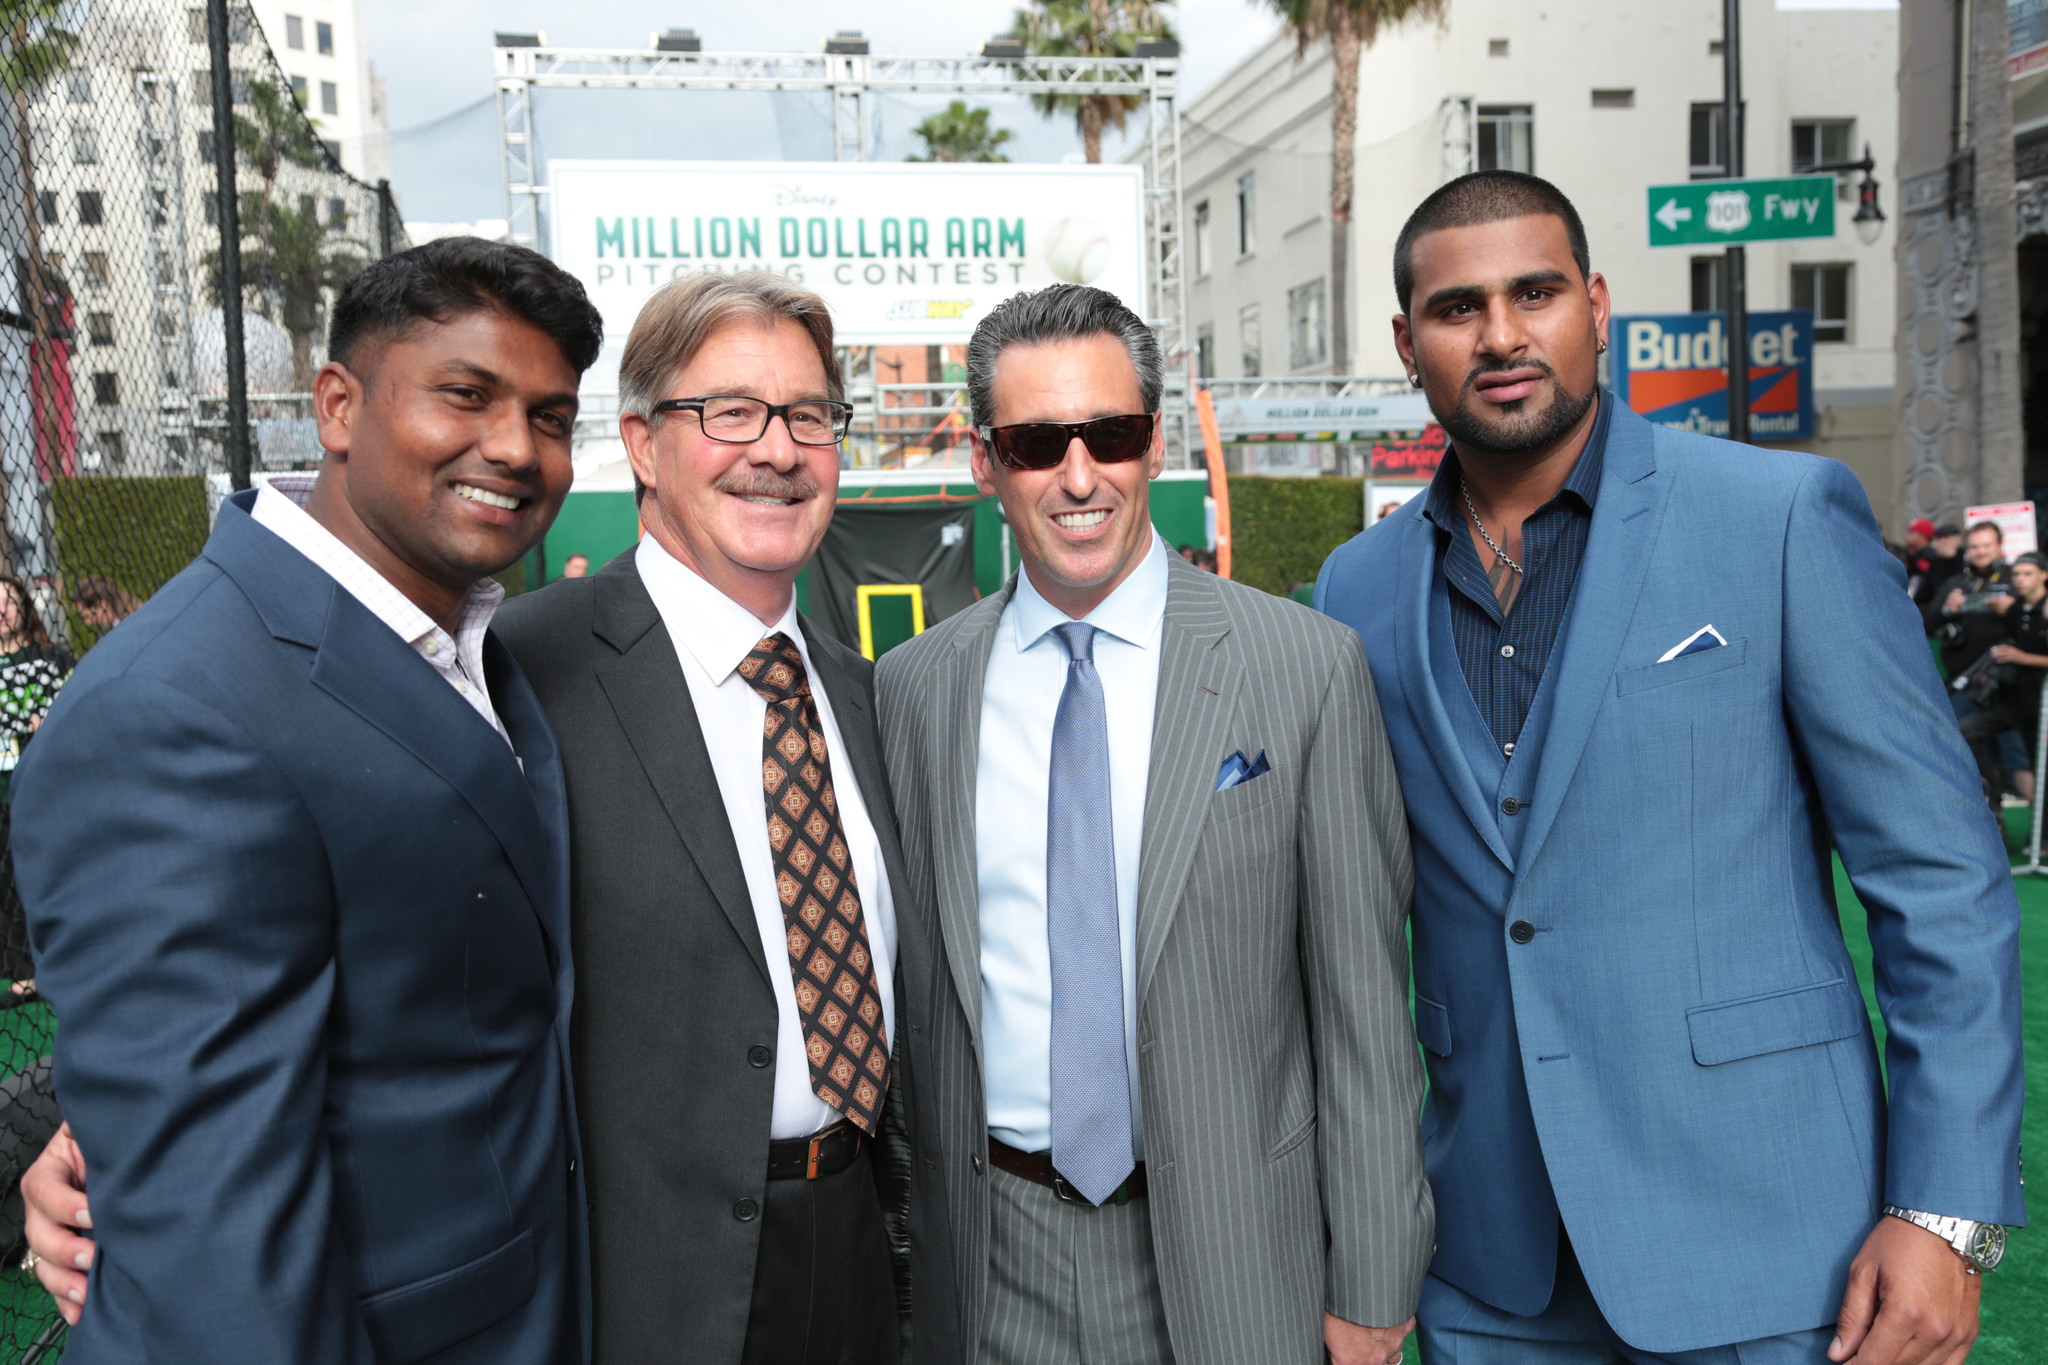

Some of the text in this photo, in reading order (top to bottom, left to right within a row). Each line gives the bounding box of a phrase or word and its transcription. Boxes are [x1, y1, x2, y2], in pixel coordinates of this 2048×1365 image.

[769, 183, 838, 210] Disney
[1715, 194, 1820, 224] 101 Fwy
[596, 217, 1025, 258] MILLION DOLLAR ARM
[835, 263, 1025, 285] CONTEST
[1628, 319, 1799, 376] Budet
